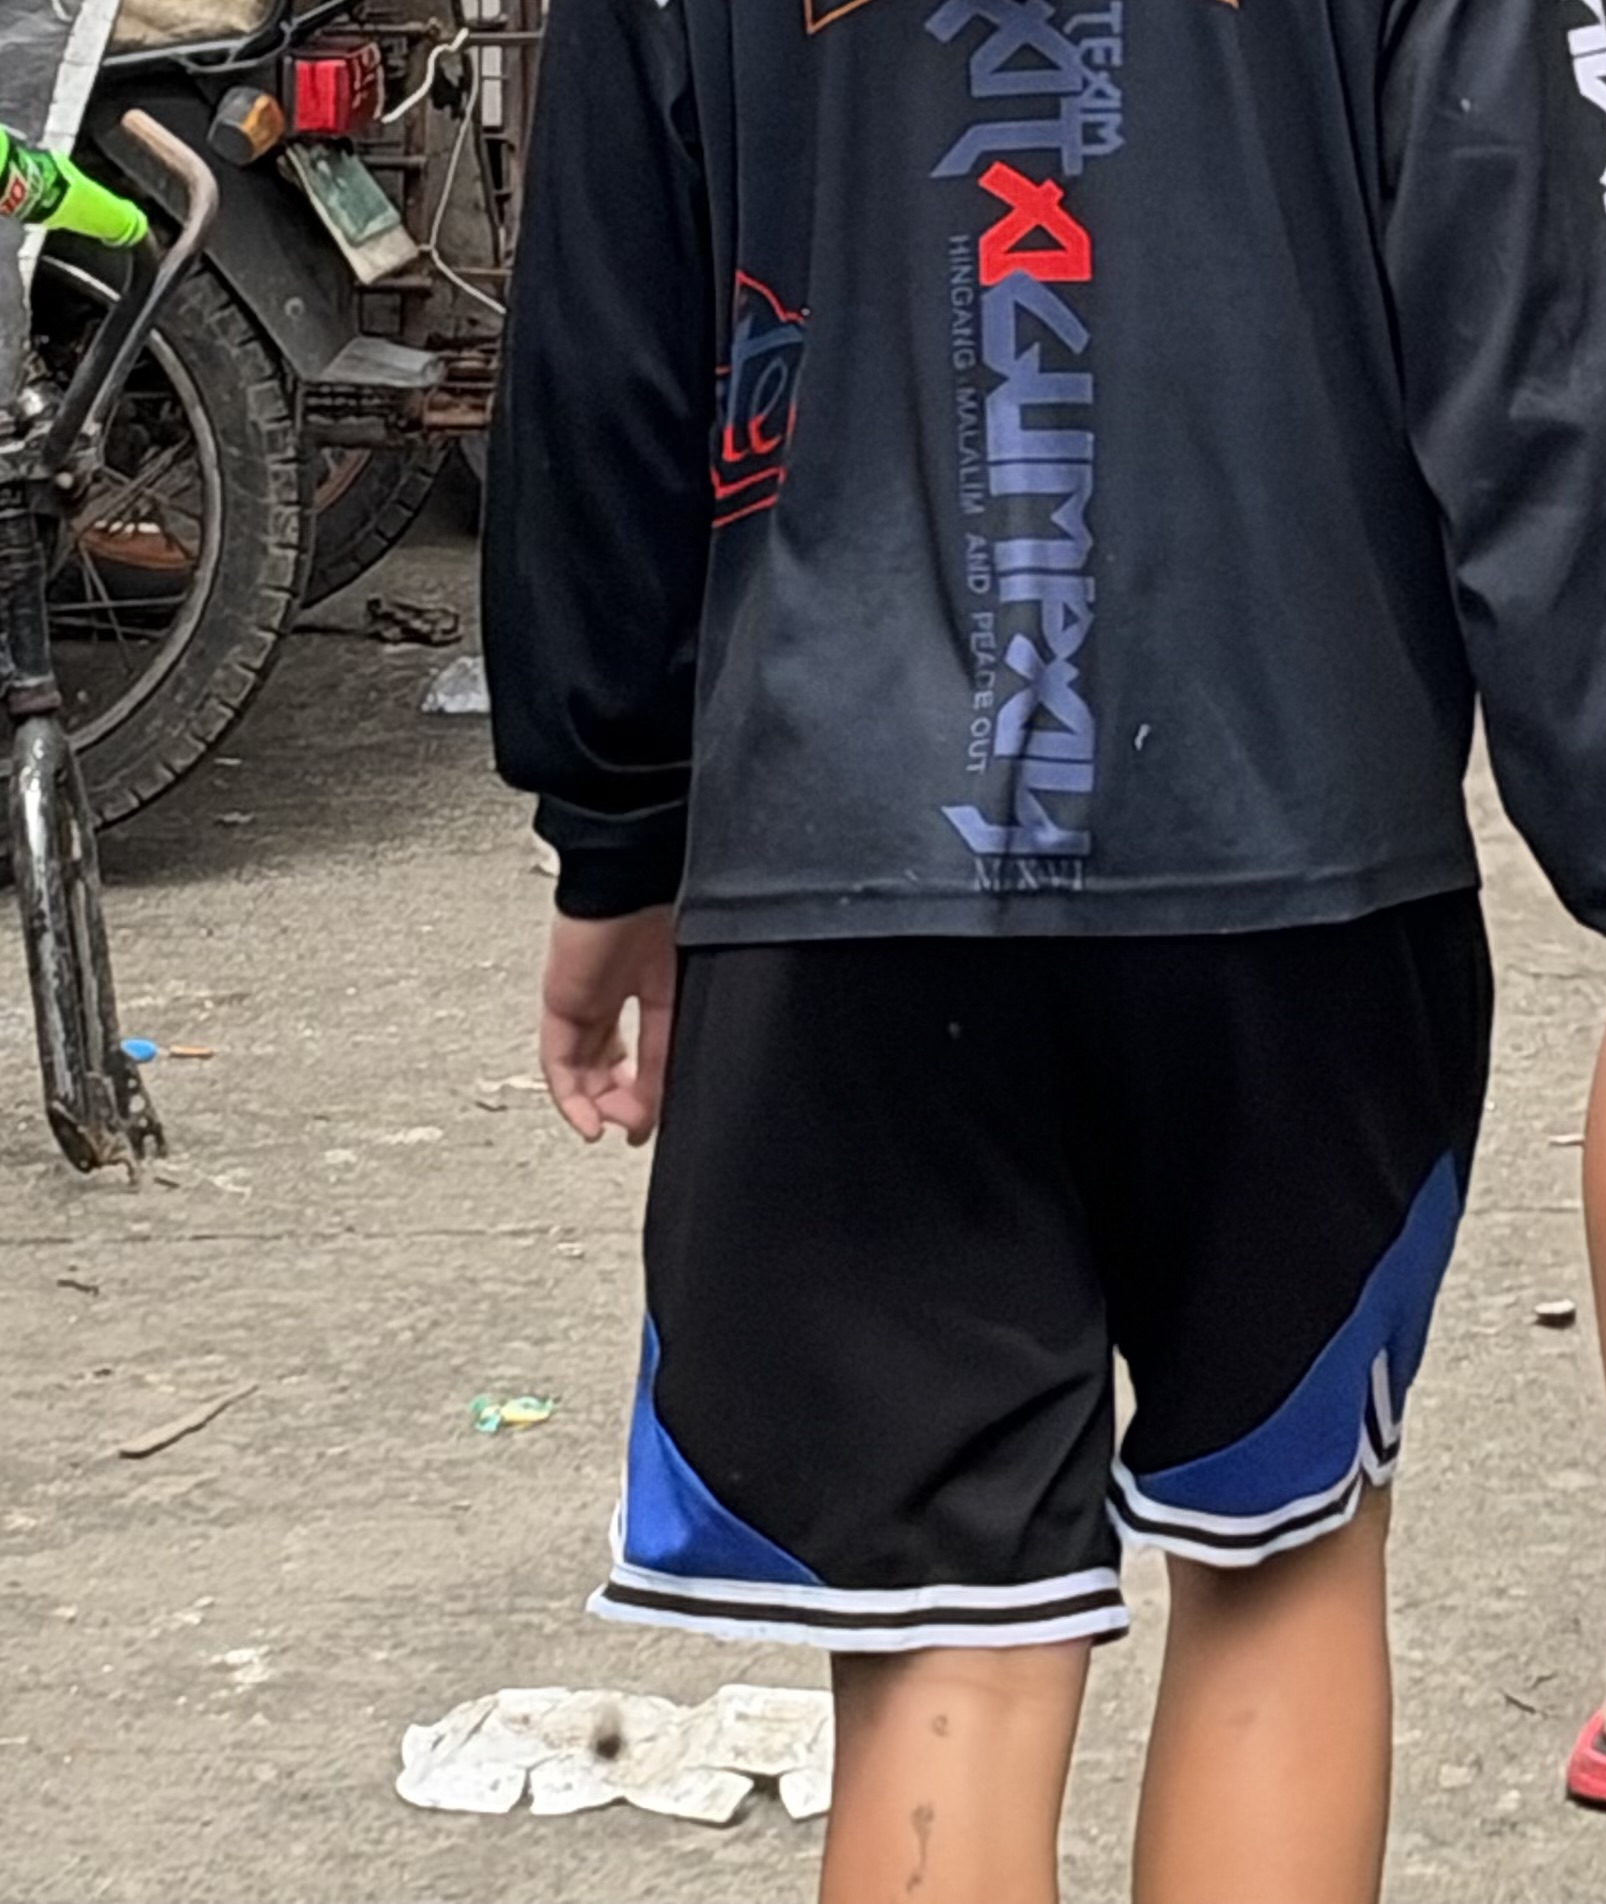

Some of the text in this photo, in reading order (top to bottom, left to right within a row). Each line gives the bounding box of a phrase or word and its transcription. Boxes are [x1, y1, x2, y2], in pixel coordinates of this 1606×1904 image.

[947, 234, 977, 370] HINGANG
[963, 533, 993, 595] AND
[965, 717, 993, 776] OUT
